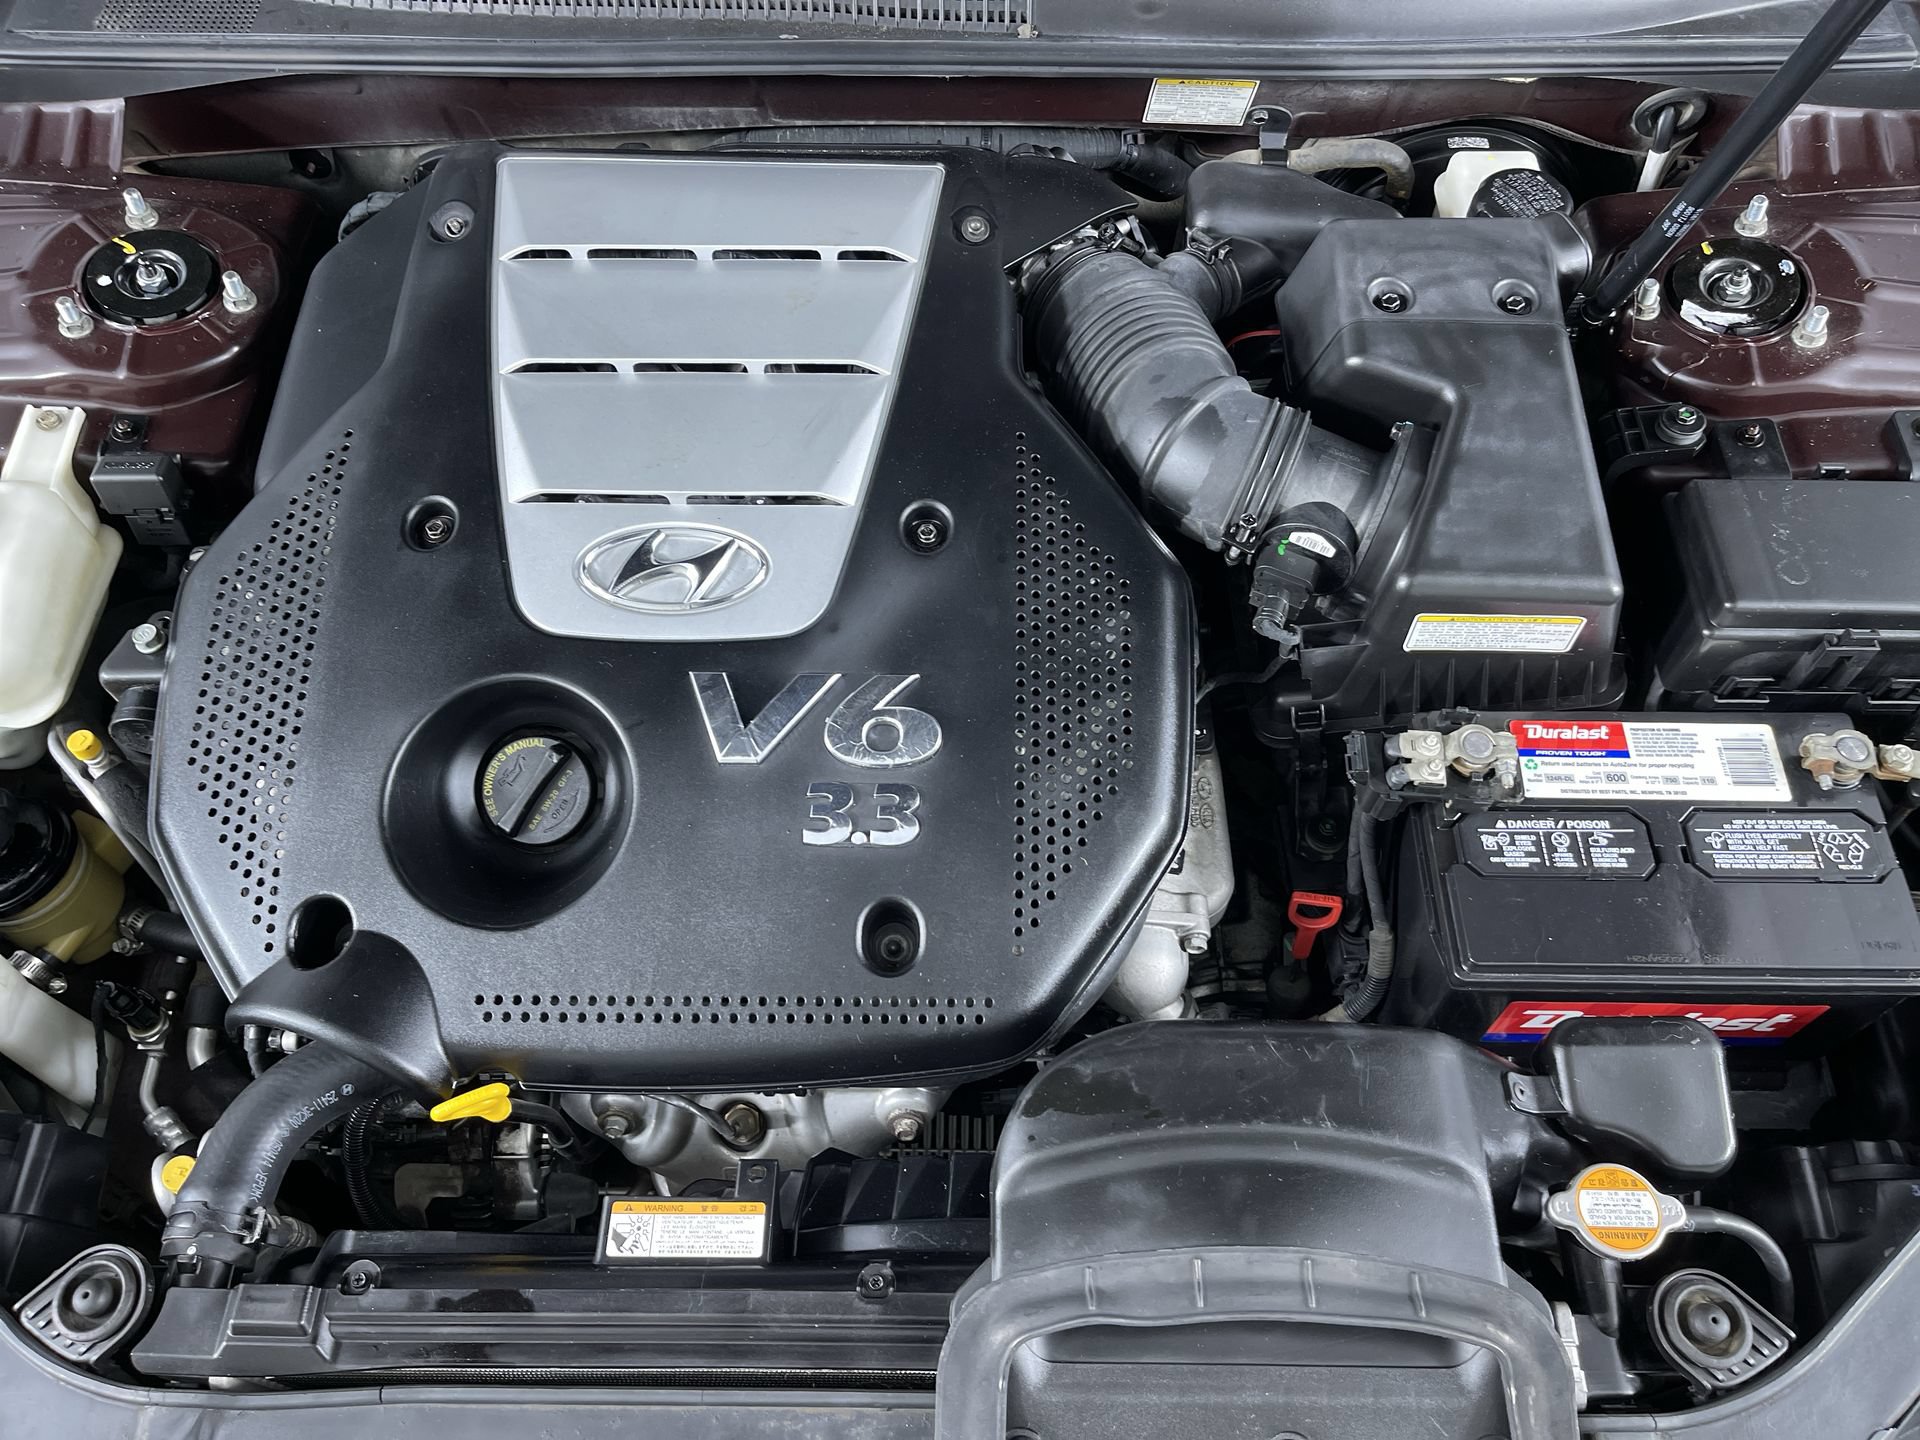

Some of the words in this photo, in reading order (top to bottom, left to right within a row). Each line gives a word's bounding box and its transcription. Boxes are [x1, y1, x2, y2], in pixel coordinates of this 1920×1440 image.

[688, 671, 943, 767] V6
[1523, 724, 1610, 740] Duralast
[505, 739, 546, 756] MANUAL
[483, 754, 506, 796] OWNER'S
[1607, 774, 1626, 782] 600
[485, 798, 498, 817] SEE
[802, 782, 921, 845] 3.3
[1507, 820, 1556, 829] DANGER
[1566, 820, 1610, 829] POISON
[290, 1090, 339, 1128] 25411-3K200
